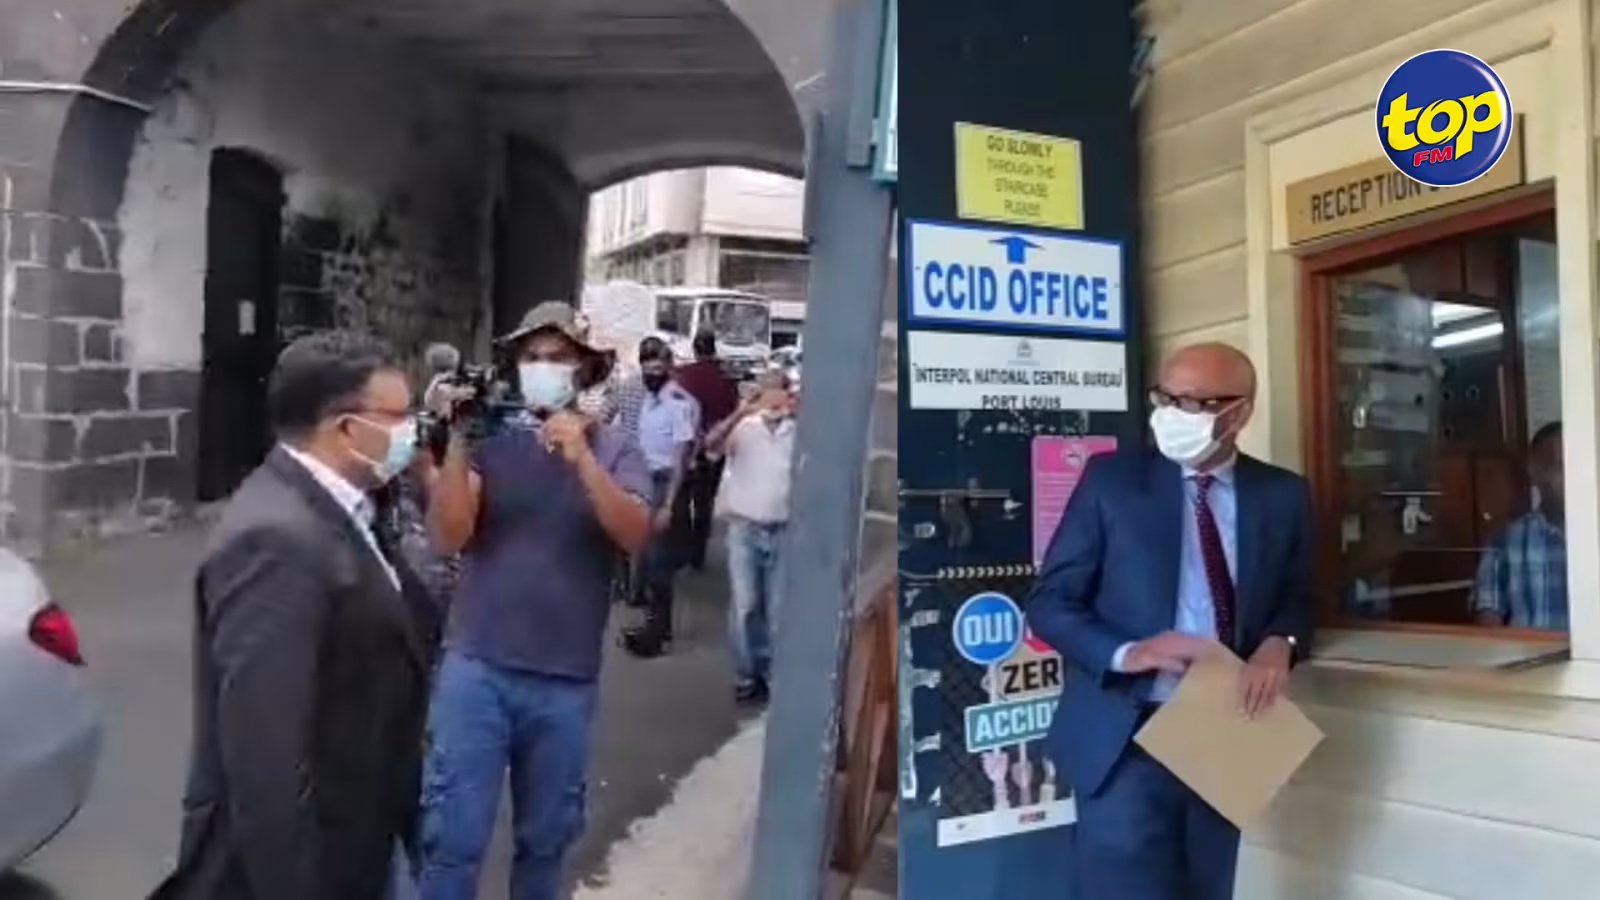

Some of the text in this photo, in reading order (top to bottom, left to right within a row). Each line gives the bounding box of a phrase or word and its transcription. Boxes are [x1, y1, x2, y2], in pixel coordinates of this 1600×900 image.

[986, 134, 1004, 152] GO
[1311, 170, 1421, 224] RECEPTION
[924, 261, 1108, 320] CCID OFFICE
[915, 368, 1123, 388] INTERPOL NATIONAL CENTRAL BUREAU
[982, 394, 1061, 411] PORT LOUIS
[963, 612, 1014, 646] OUI
[975, 700, 1059, 742] ACCID
